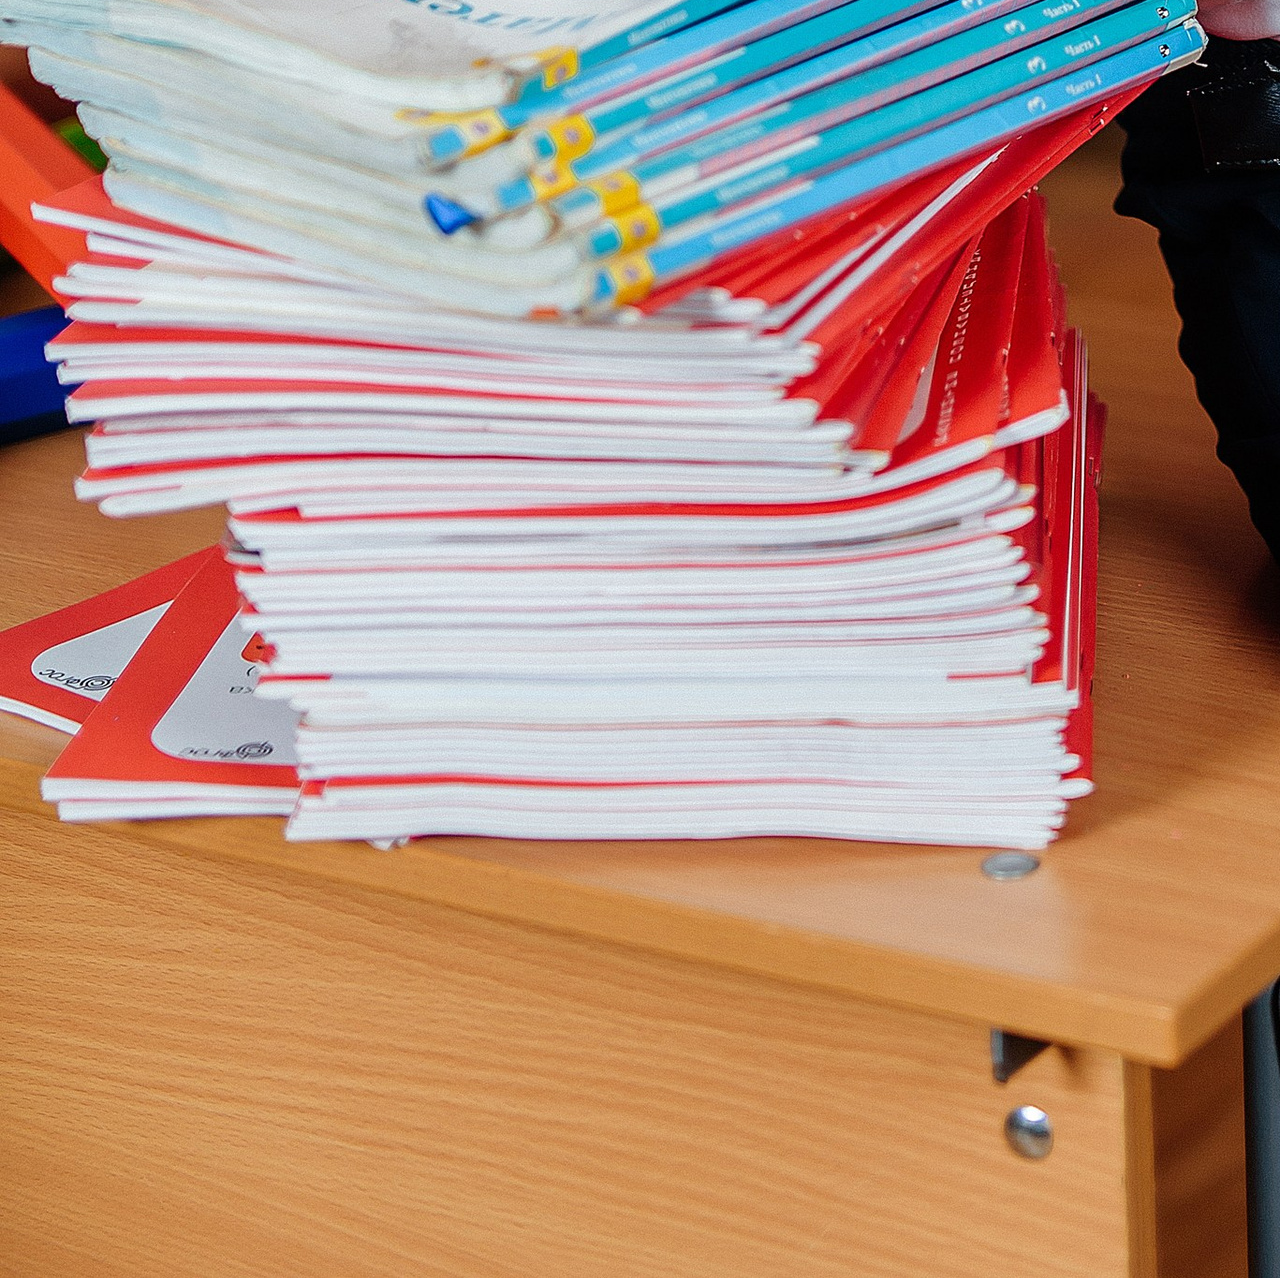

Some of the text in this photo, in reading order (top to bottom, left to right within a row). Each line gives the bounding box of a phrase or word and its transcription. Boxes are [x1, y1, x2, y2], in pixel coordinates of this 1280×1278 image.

[1043, 4, 1074, 18] Часть
[1064, 41, 1094, 56] Часть
[1066, 80, 1095, 95] Часть
